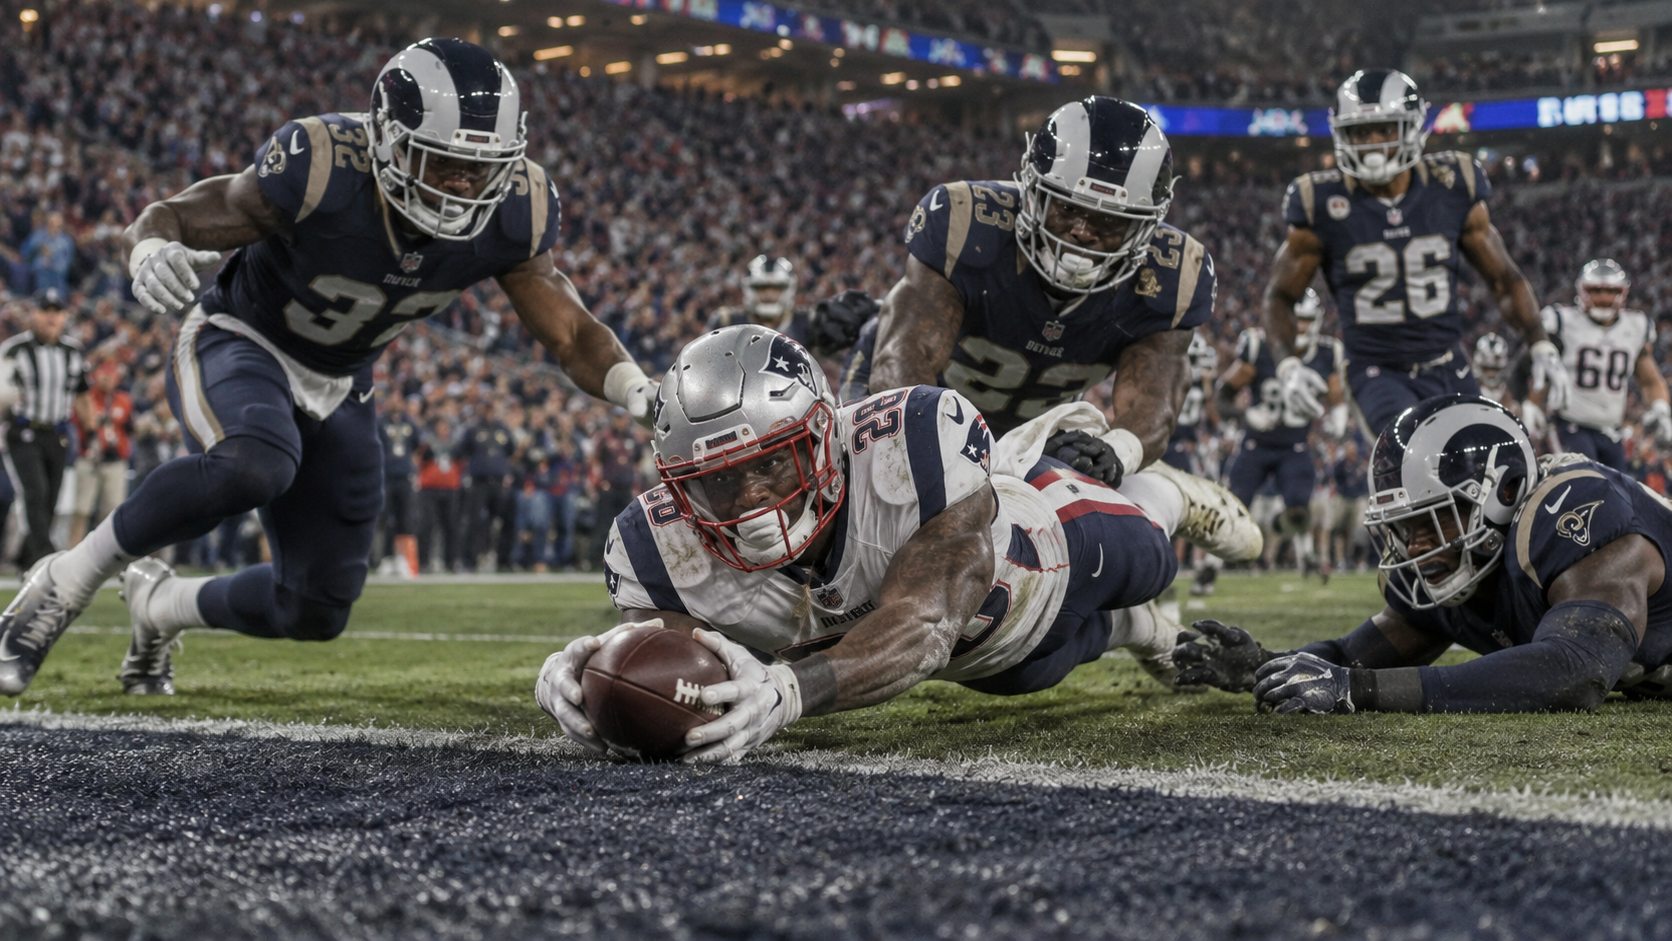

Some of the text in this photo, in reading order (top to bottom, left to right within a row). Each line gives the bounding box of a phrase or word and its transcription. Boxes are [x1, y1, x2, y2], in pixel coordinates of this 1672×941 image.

[328, 123, 371, 173] 32
[971, 184, 1015, 231] 23
[1345, 233, 1451, 324] 26
[1576, 345, 1629, 391] 60
